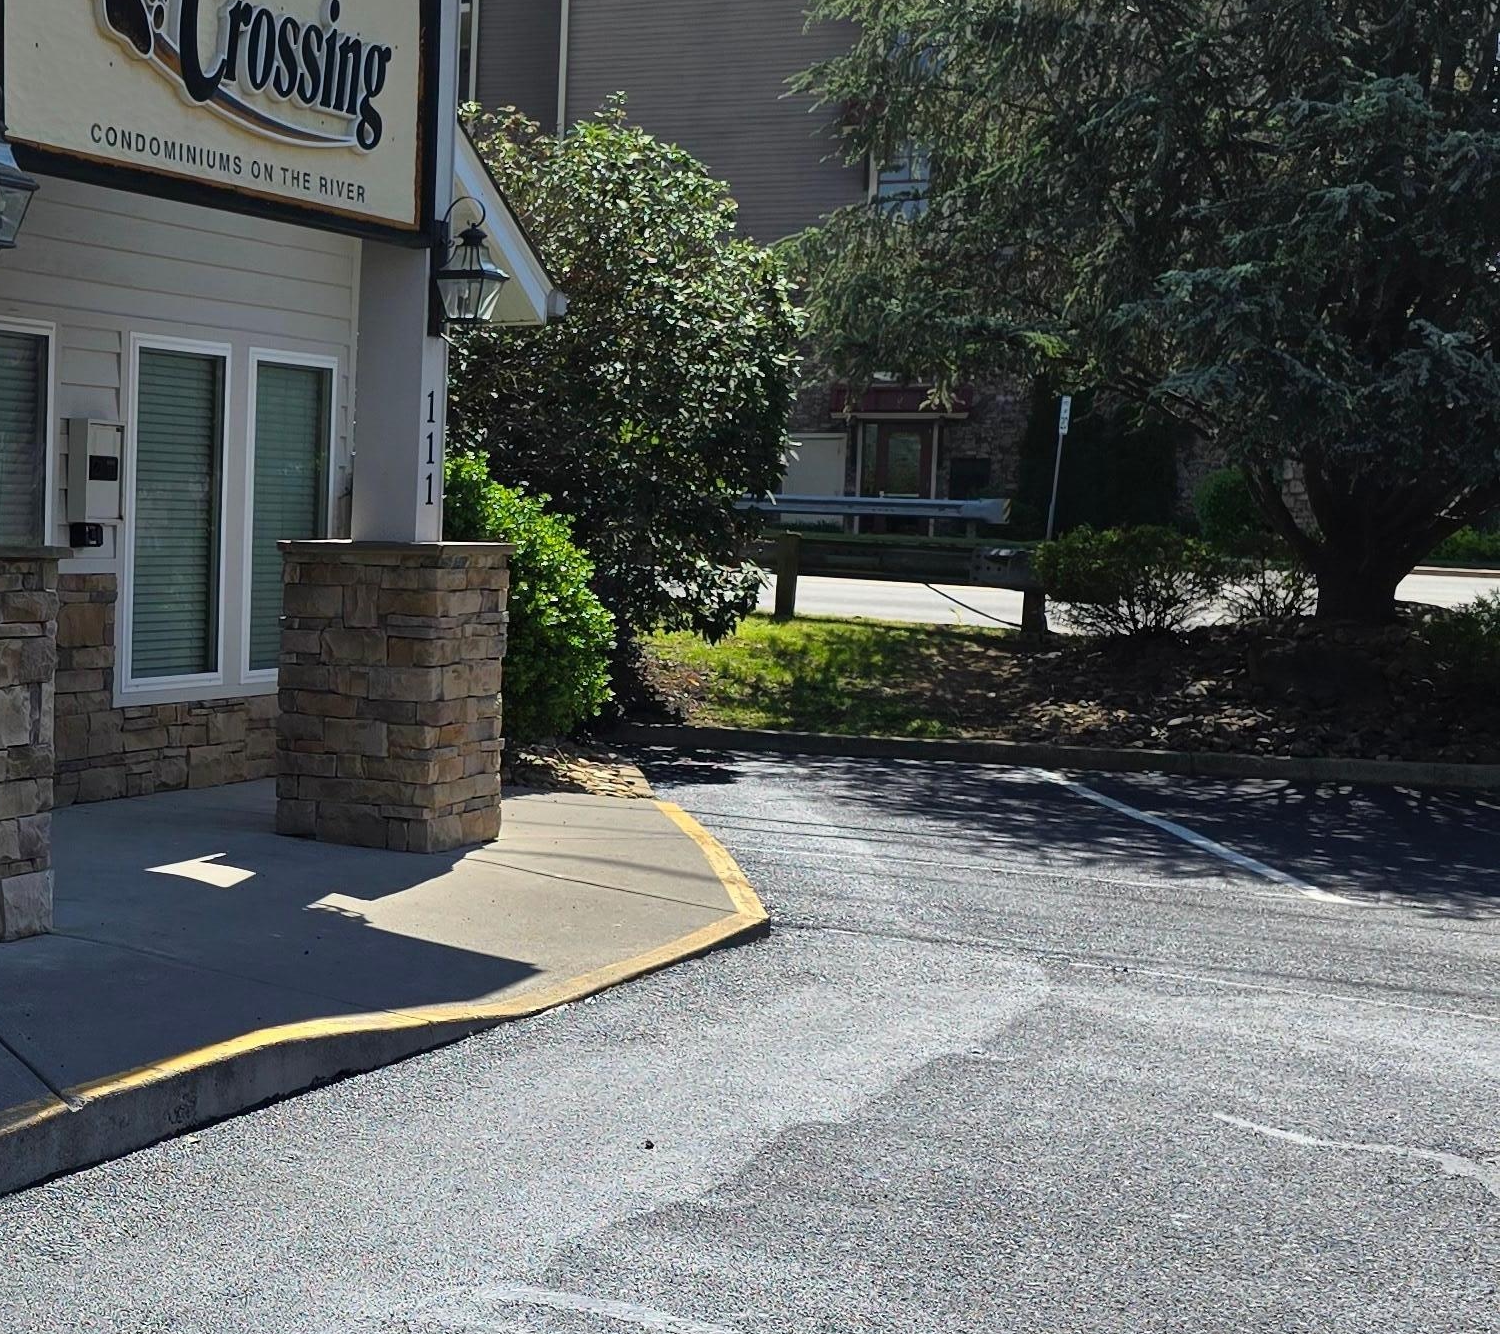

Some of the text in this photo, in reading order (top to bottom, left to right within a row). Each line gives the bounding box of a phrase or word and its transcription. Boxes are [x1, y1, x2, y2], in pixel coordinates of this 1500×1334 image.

[90, 122, 366, 204] CONDOMINIUMS ON THE RIVER
[425, 390, 436, 506] 111
